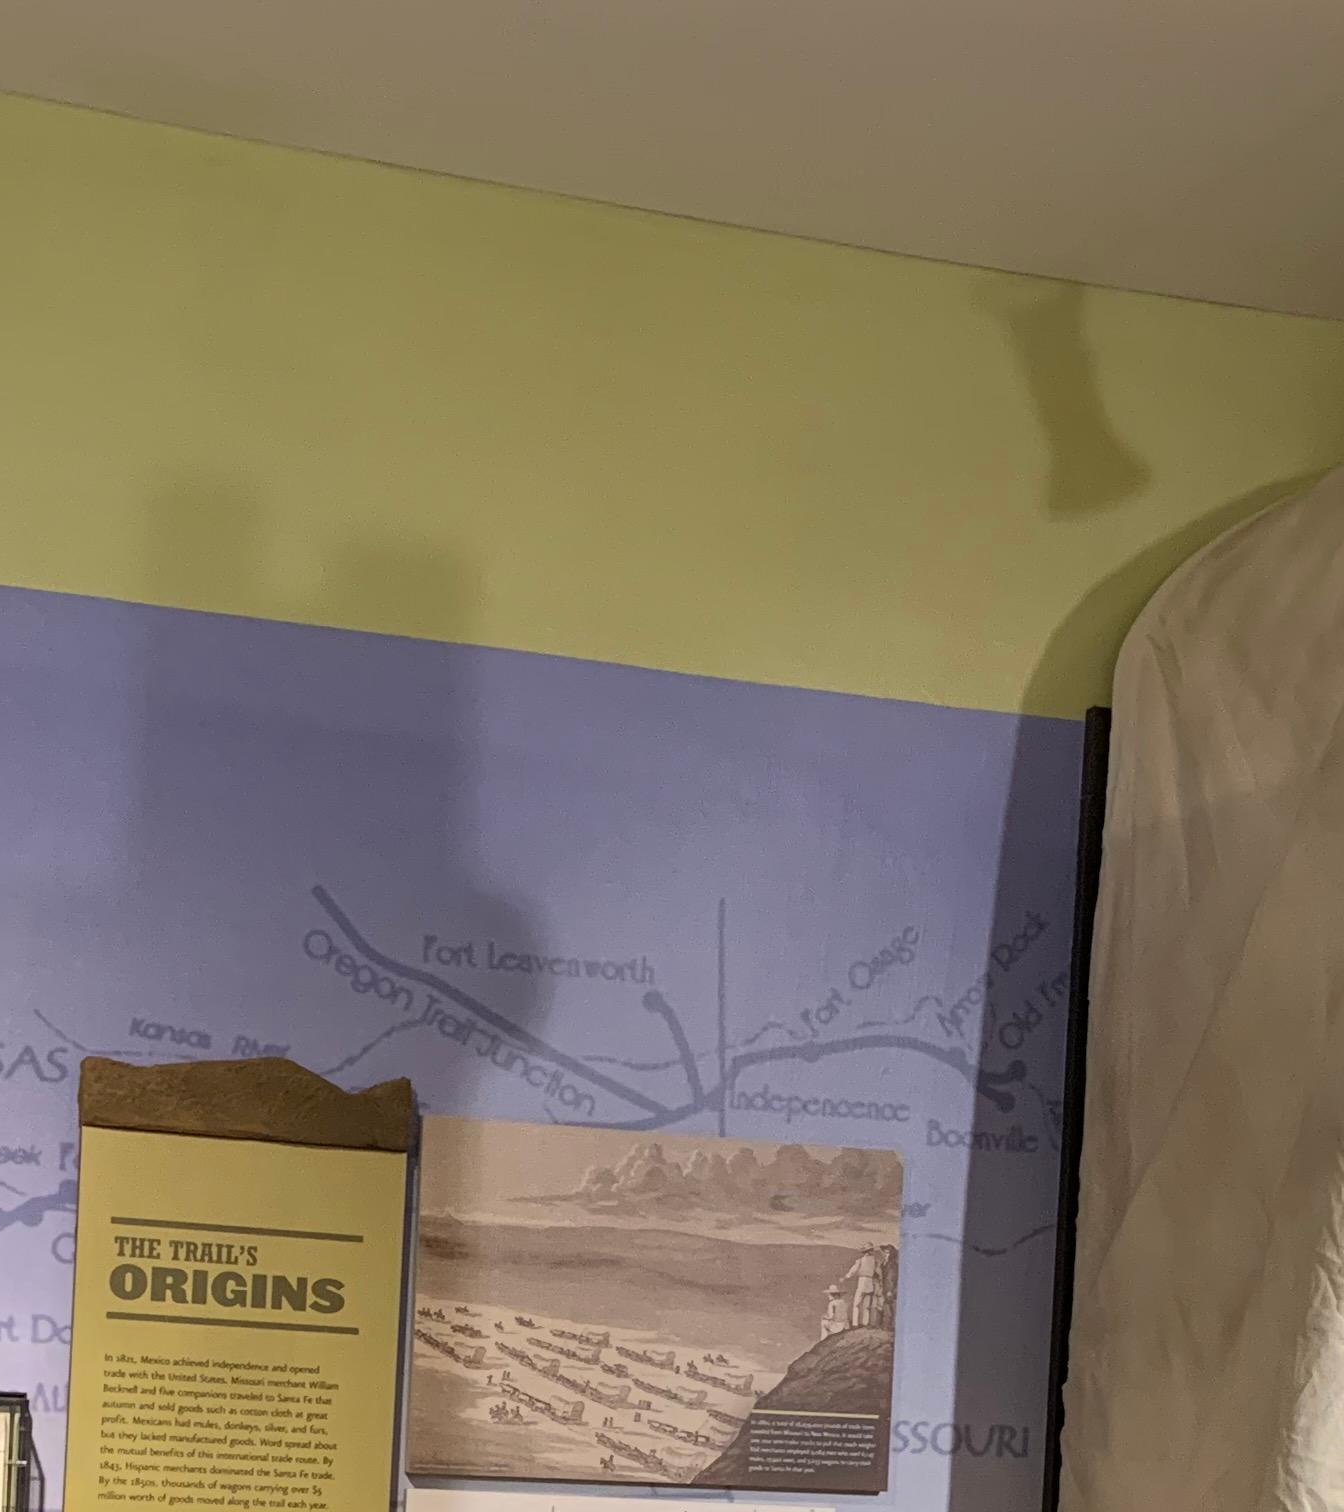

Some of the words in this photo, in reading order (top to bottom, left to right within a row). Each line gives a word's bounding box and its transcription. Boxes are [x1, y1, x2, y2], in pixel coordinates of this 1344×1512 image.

[302, 928, 414, 1011] Oregon
[488, 939, 656, 985] Leavenworth
[128, 1016, 212, 1050] Kansas
[114, 1236, 161, 1260] THE
[169, 1240, 258, 1267] TRAIL'S
[109, 1264, 345, 1314] ORIGINS
[892, 1421, 1031, 1458] SSOURI
